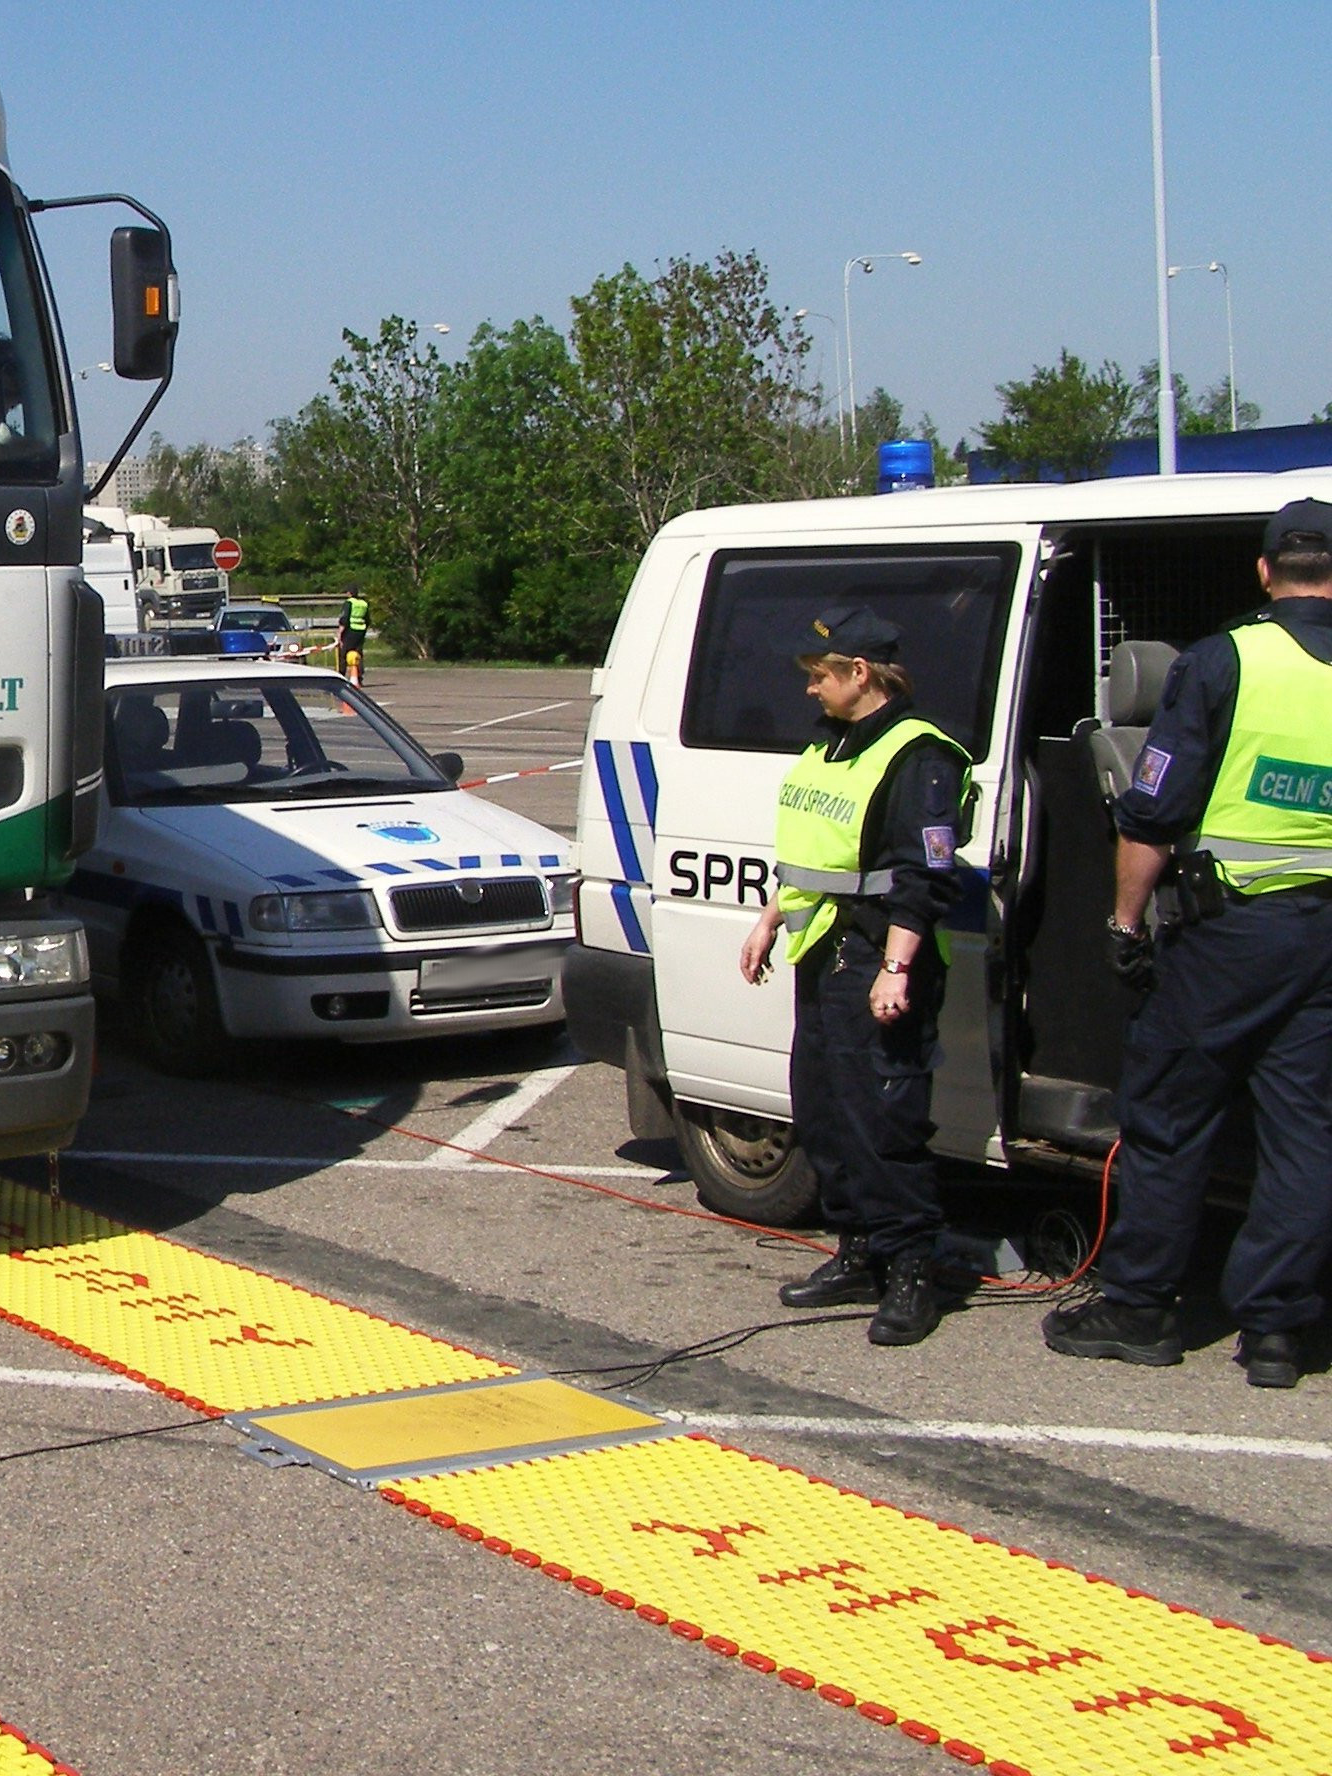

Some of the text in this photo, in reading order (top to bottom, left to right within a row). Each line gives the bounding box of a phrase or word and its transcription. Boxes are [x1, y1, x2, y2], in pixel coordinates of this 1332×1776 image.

[779, 783, 856, 824] CELNÍ SPRÁVA
[1259, 771, 1332, 807] CELNÍ S
[669, 850, 771, 907] SPR
[630, 1520, 1275, 1758] VAHY
